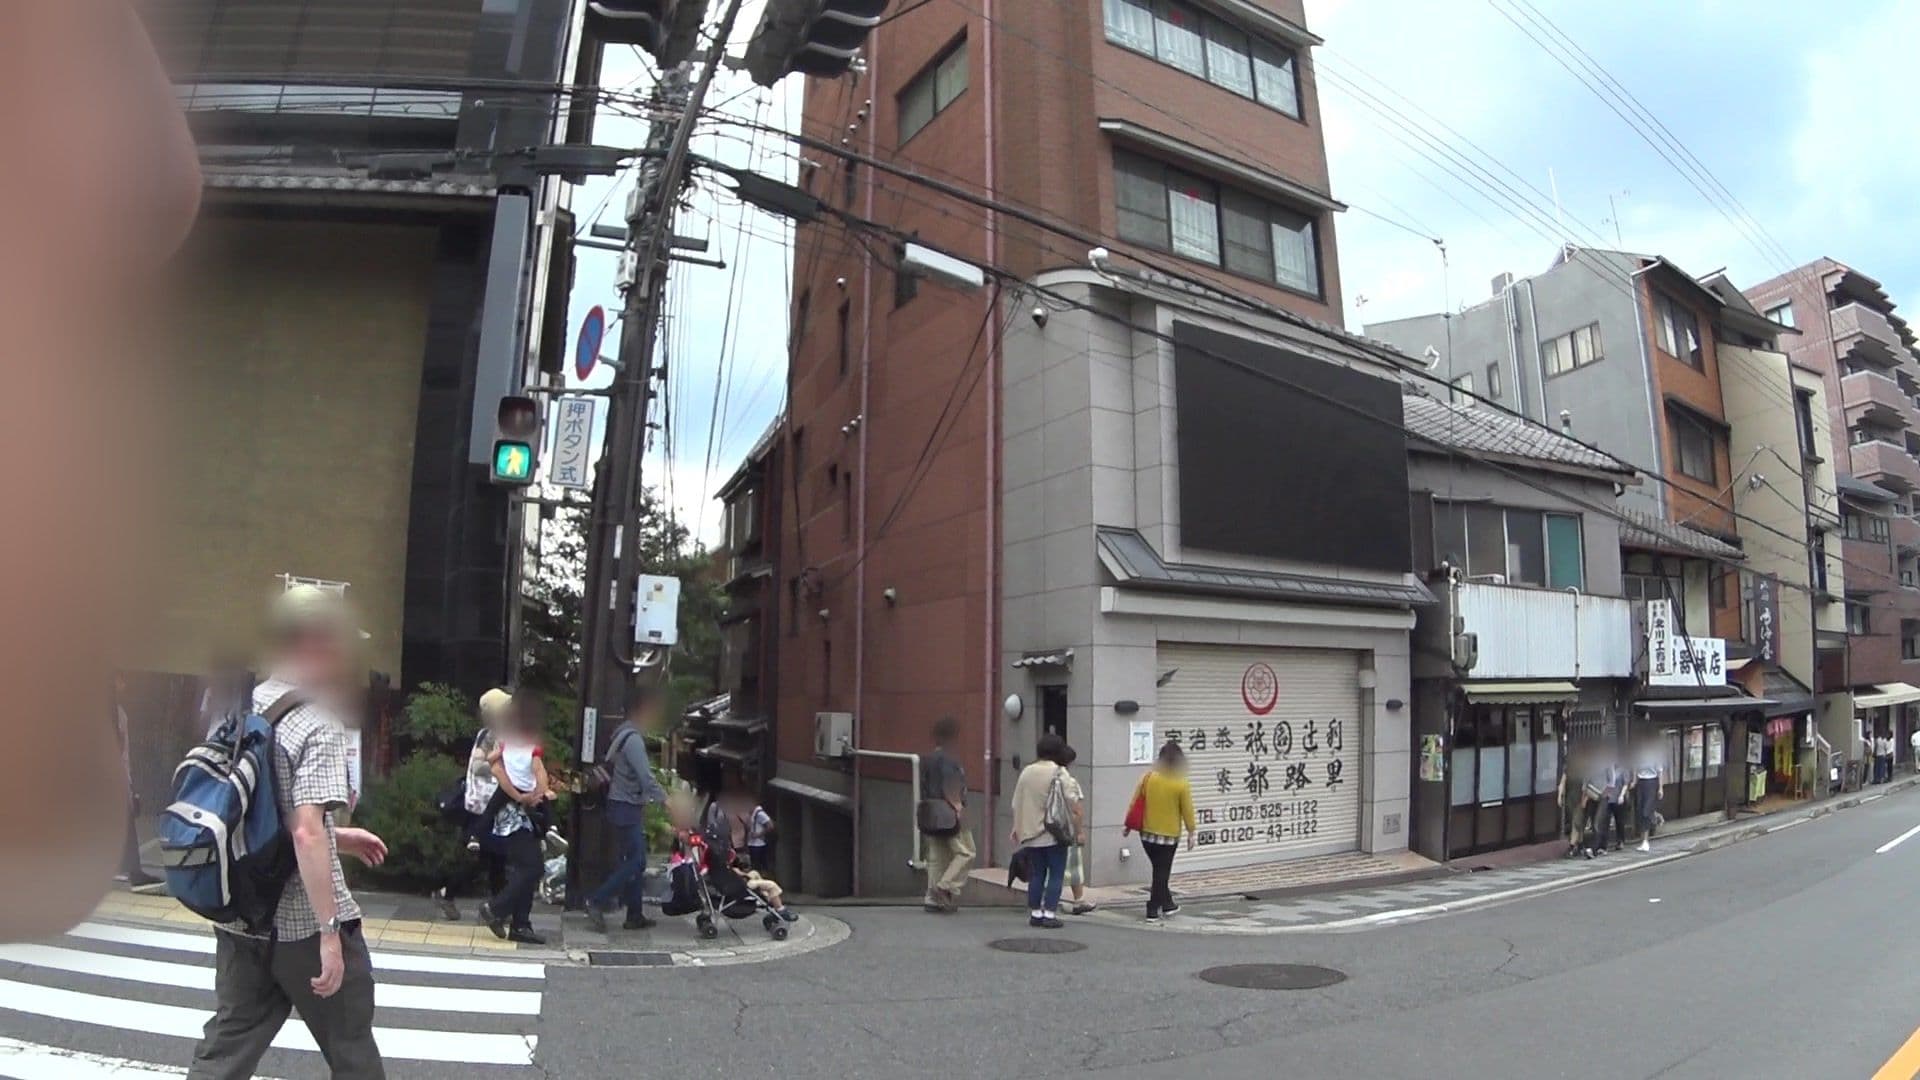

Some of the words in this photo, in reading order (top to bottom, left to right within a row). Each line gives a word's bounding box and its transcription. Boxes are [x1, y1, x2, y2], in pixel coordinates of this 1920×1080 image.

[559, 402, 586, 482] 押ボタン式
[1243, 758, 1344, 798] 都路里
[1197, 809, 1216, 824] TEL
[1220, 819, 1318, 843] 0120-43-1122
